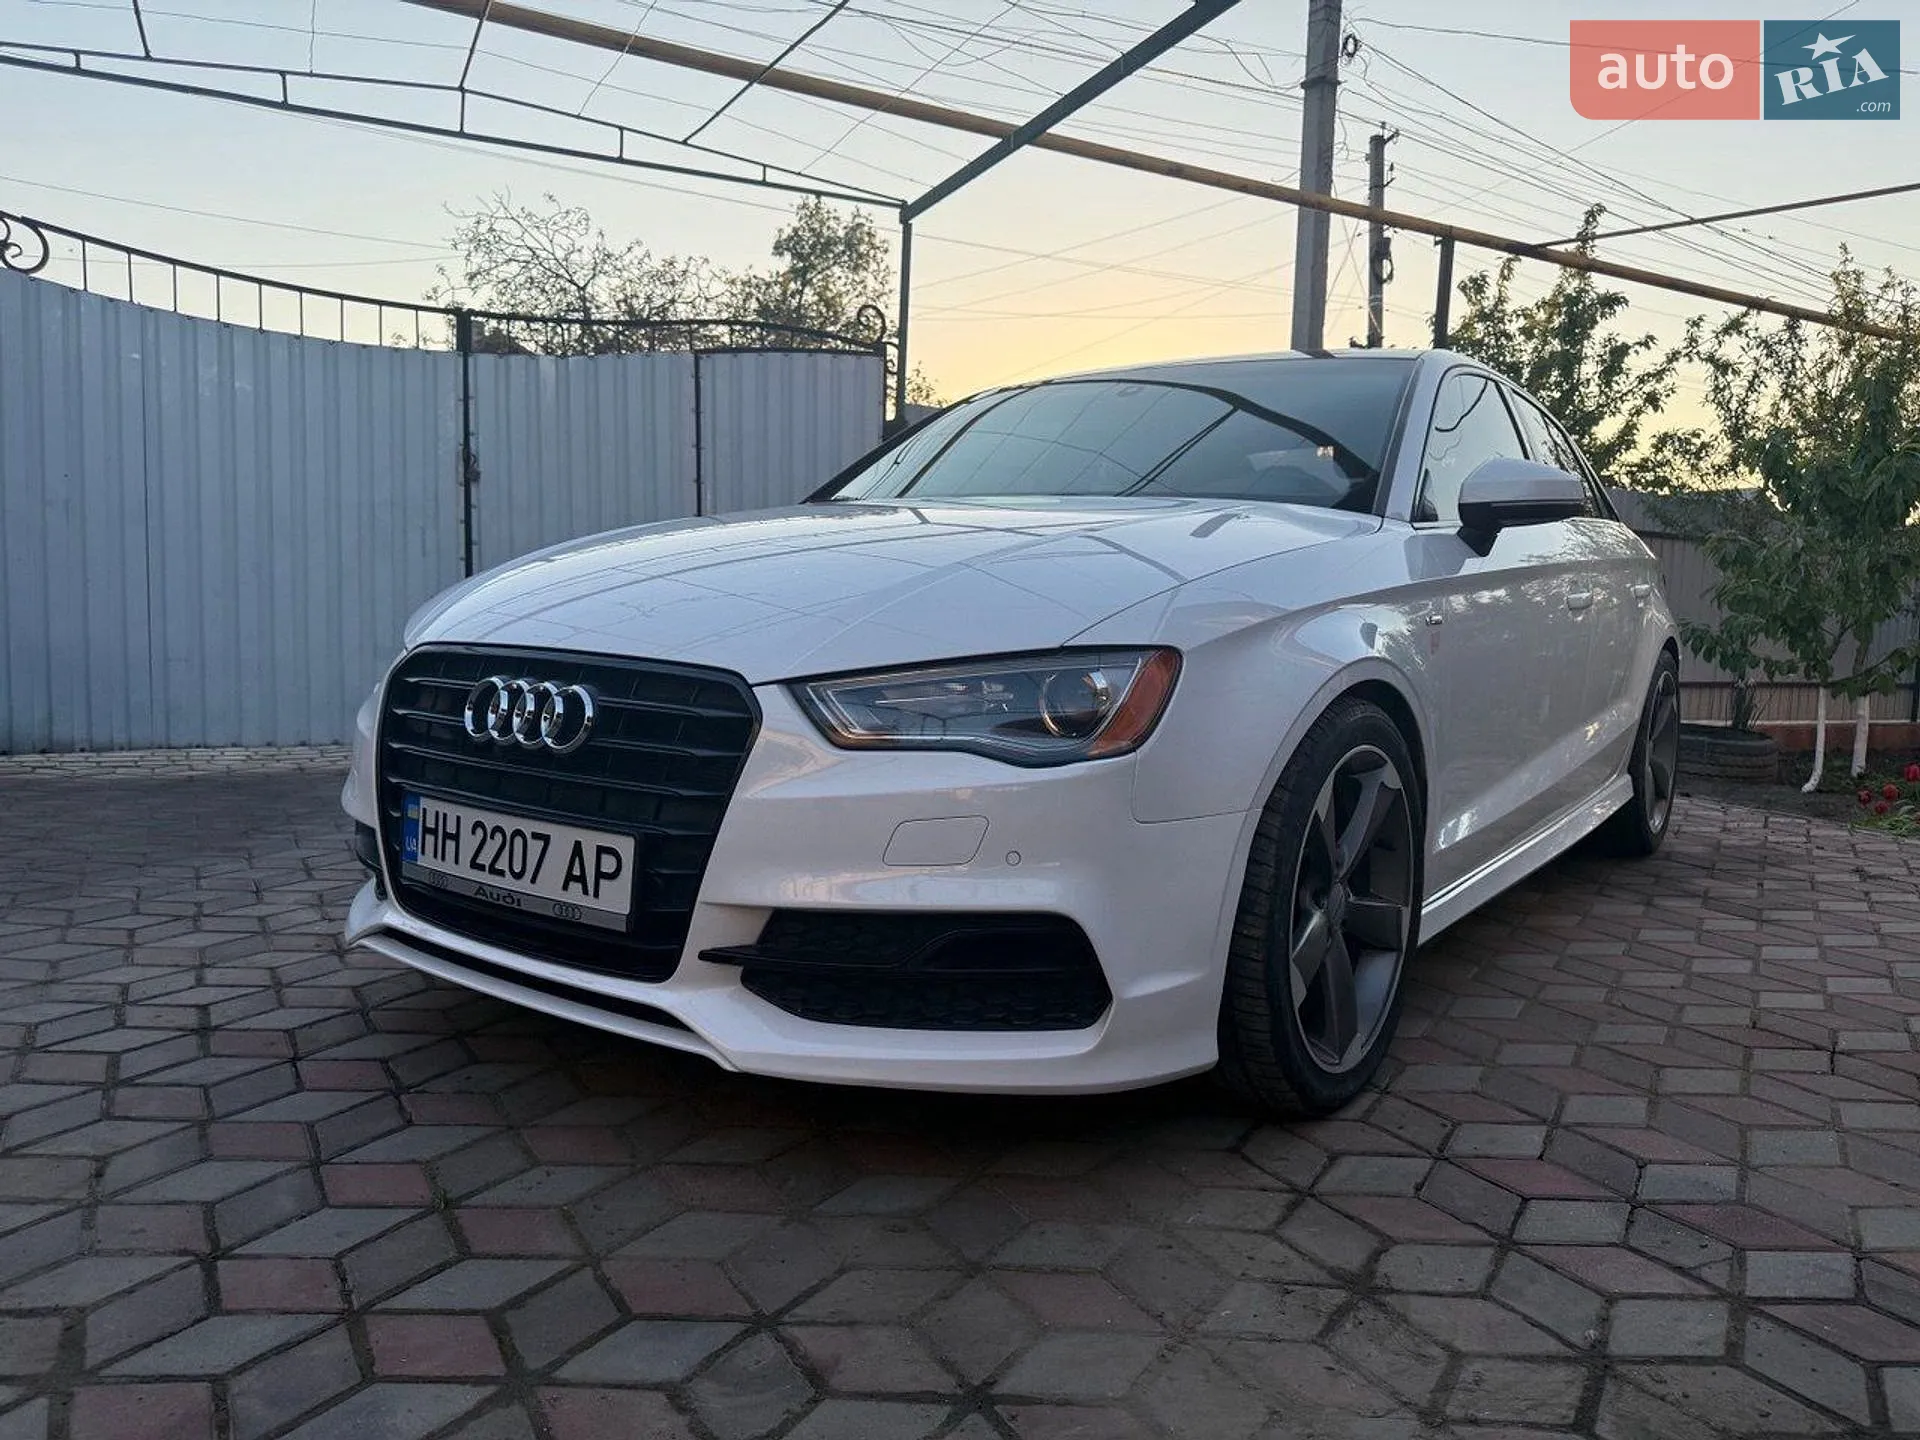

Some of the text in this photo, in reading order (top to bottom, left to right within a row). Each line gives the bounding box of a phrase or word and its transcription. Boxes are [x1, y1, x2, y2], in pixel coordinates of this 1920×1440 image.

[421, 807, 623, 898] HH 2207 AP
